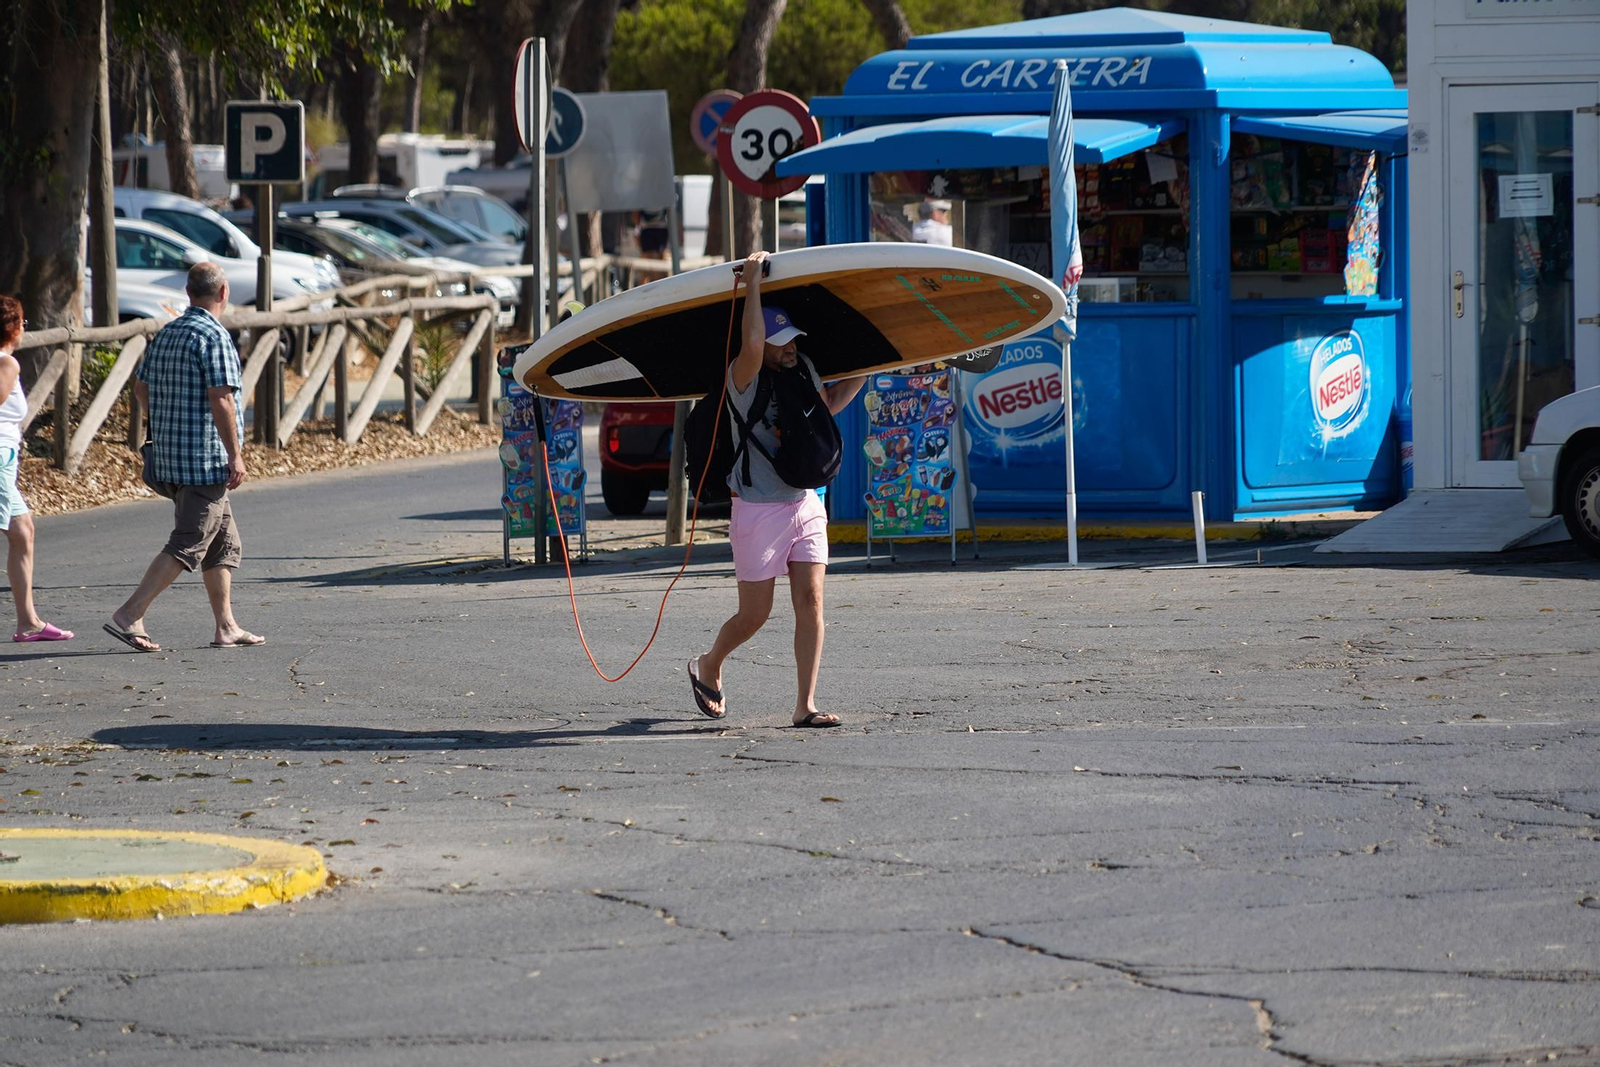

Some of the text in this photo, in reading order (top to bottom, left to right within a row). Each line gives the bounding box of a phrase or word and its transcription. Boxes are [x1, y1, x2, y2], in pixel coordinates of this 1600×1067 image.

[887, 56, 1152, 90] EL CARTERA
[241, 112, 287, 174] P
[740, 128, 794, 161] 30
[1320, 337, 1353, 364] HELADOS
[978, 372, 1062, 419] Nestlé
[1320, 364, 1361, 411] Nestlé
